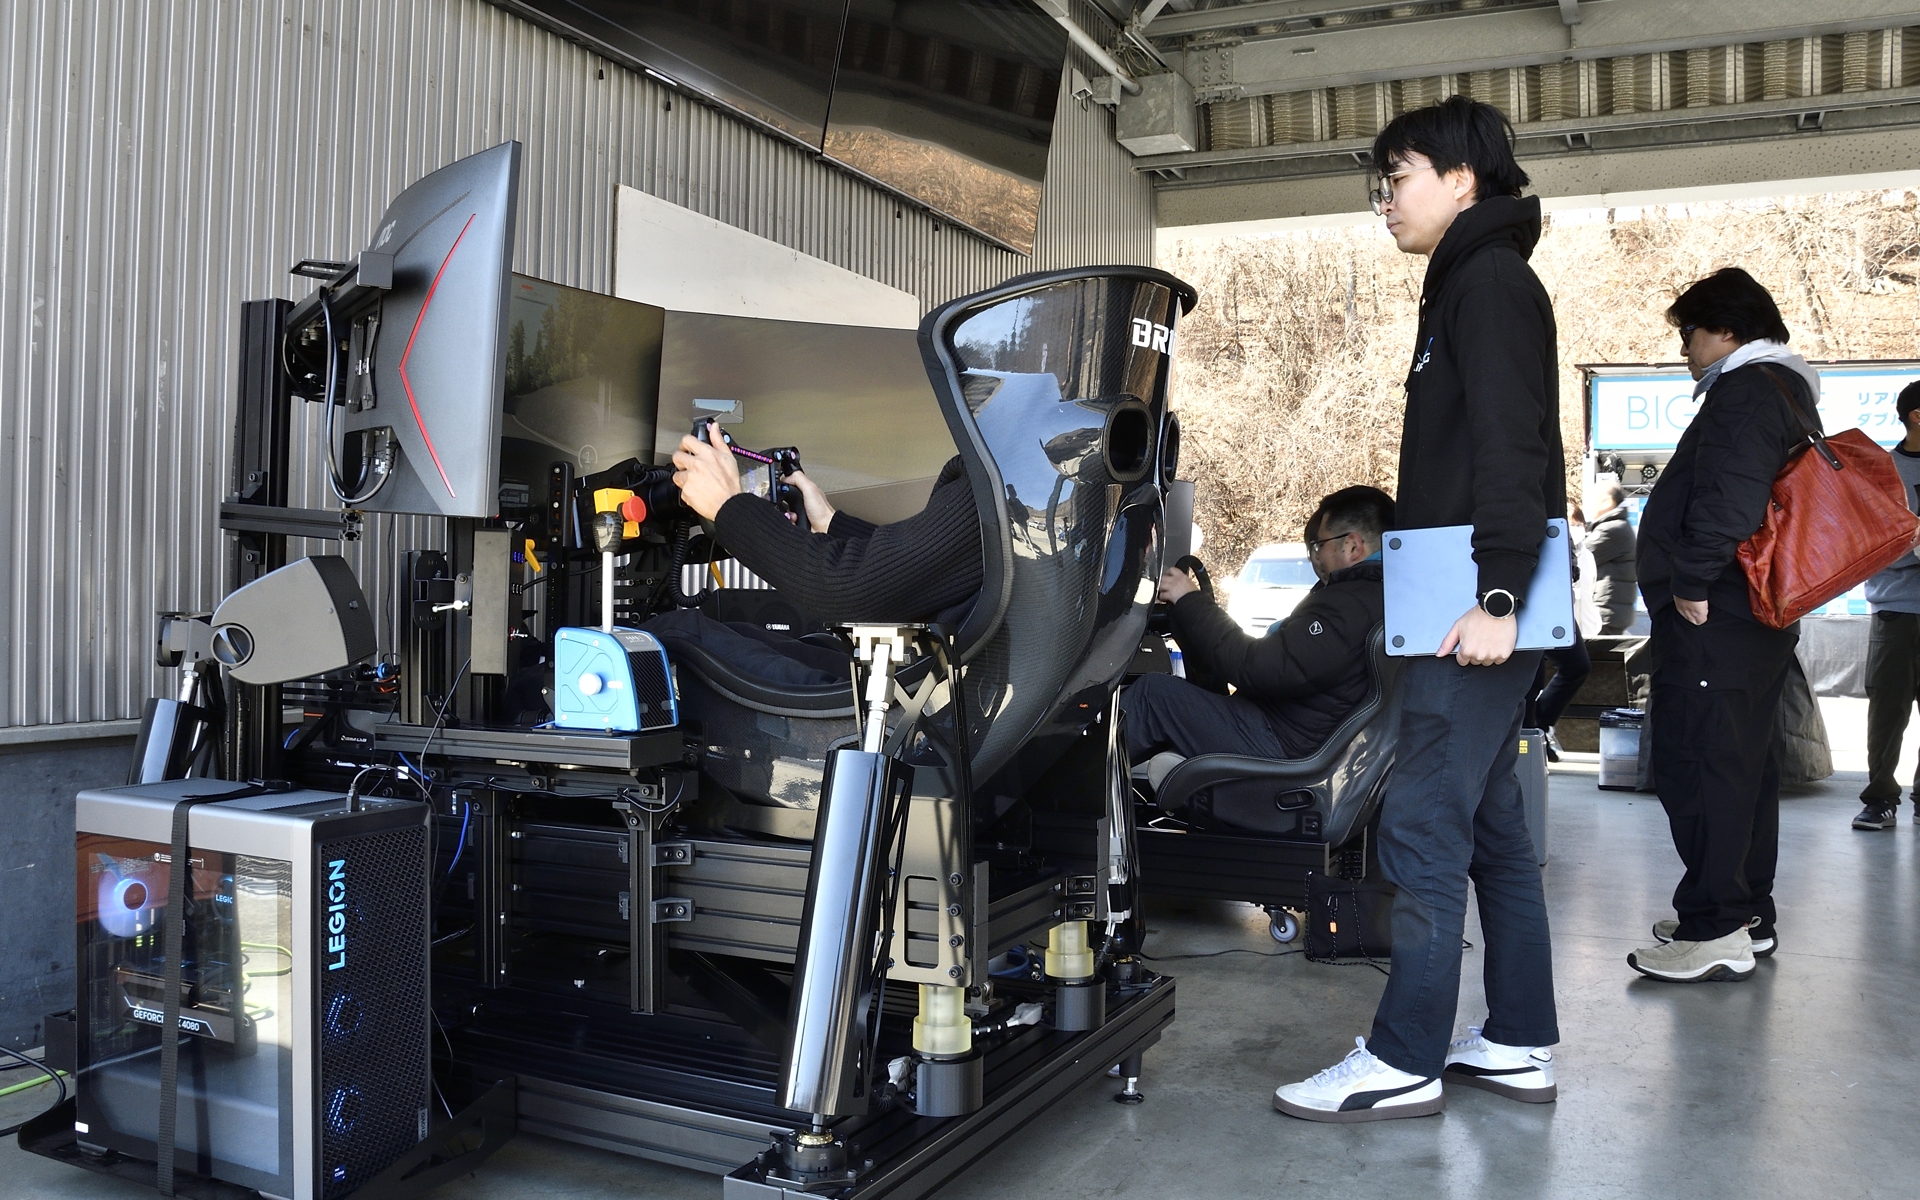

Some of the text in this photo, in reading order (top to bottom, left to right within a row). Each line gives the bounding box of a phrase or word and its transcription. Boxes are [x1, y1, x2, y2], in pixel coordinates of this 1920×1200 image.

[1132, 317, 1175, 356] BRI
[1628, 395, 1700, 430] BIG
[328, 859, 346, 971] LEGION
[181, 1021, 200, 1032] 4080
